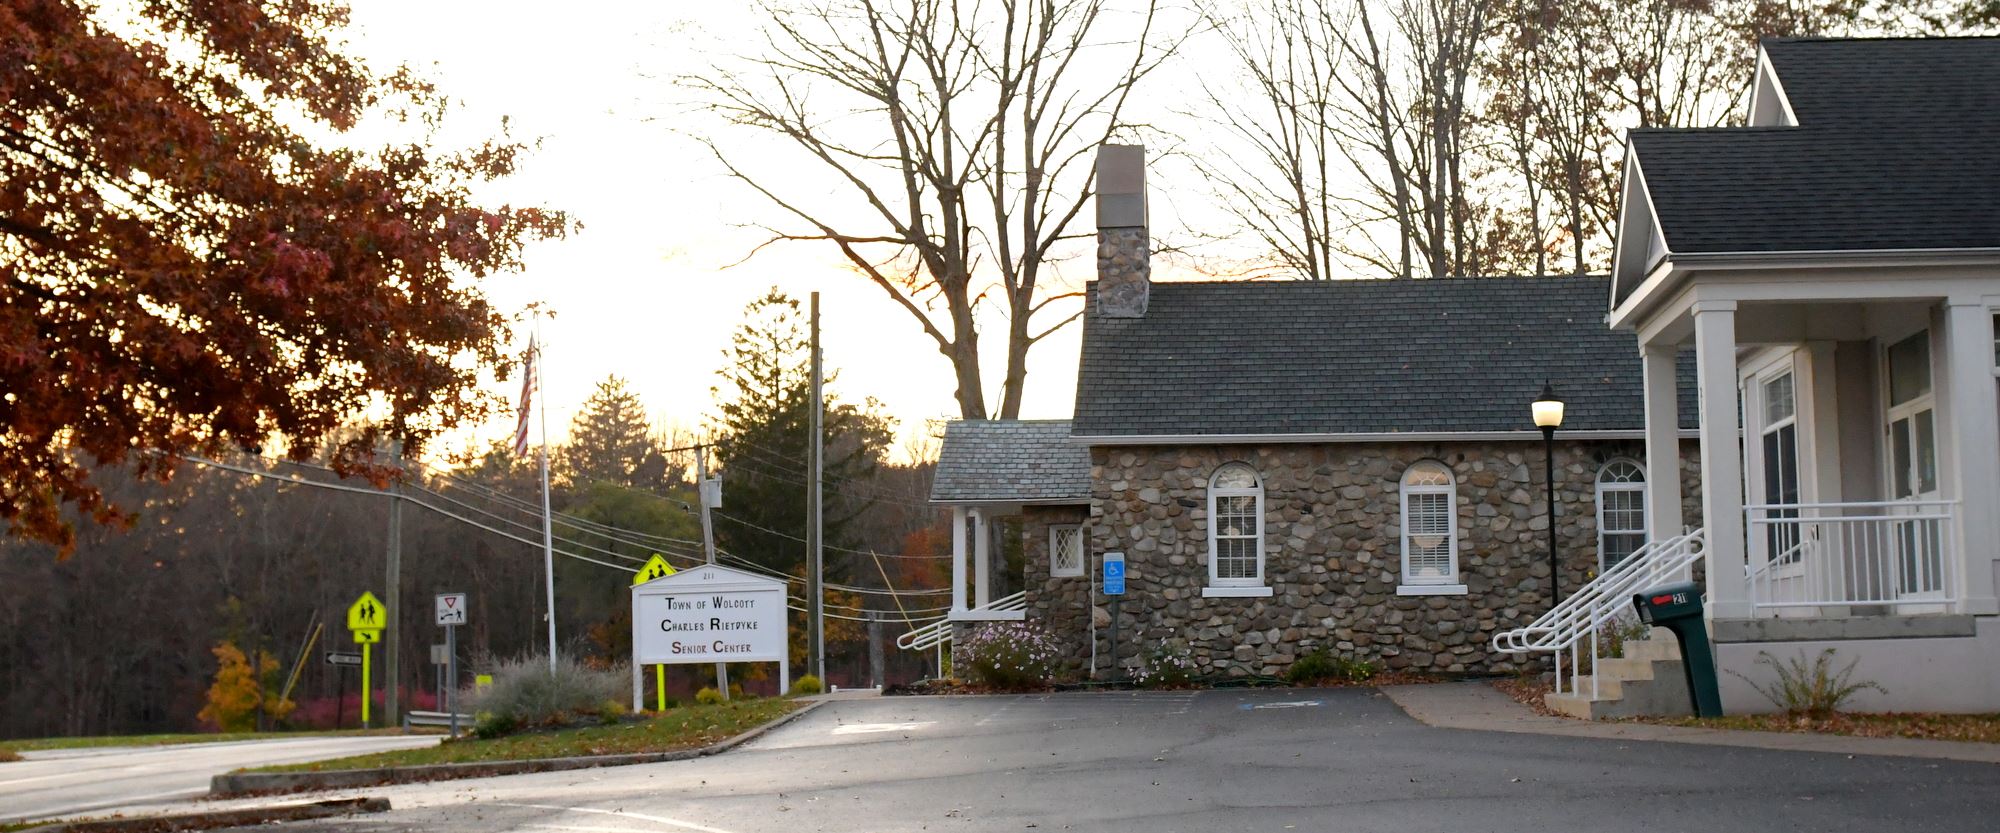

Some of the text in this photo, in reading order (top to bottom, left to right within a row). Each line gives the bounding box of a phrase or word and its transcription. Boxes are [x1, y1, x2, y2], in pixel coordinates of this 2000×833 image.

[703, 572, 714, 580] 211
[665, 596, 755, 610] TOWN OF WOLCOTT
[661, 619, 704, 632] CHARLES
[671, 640, 752, 654] SENIOR CENTER
